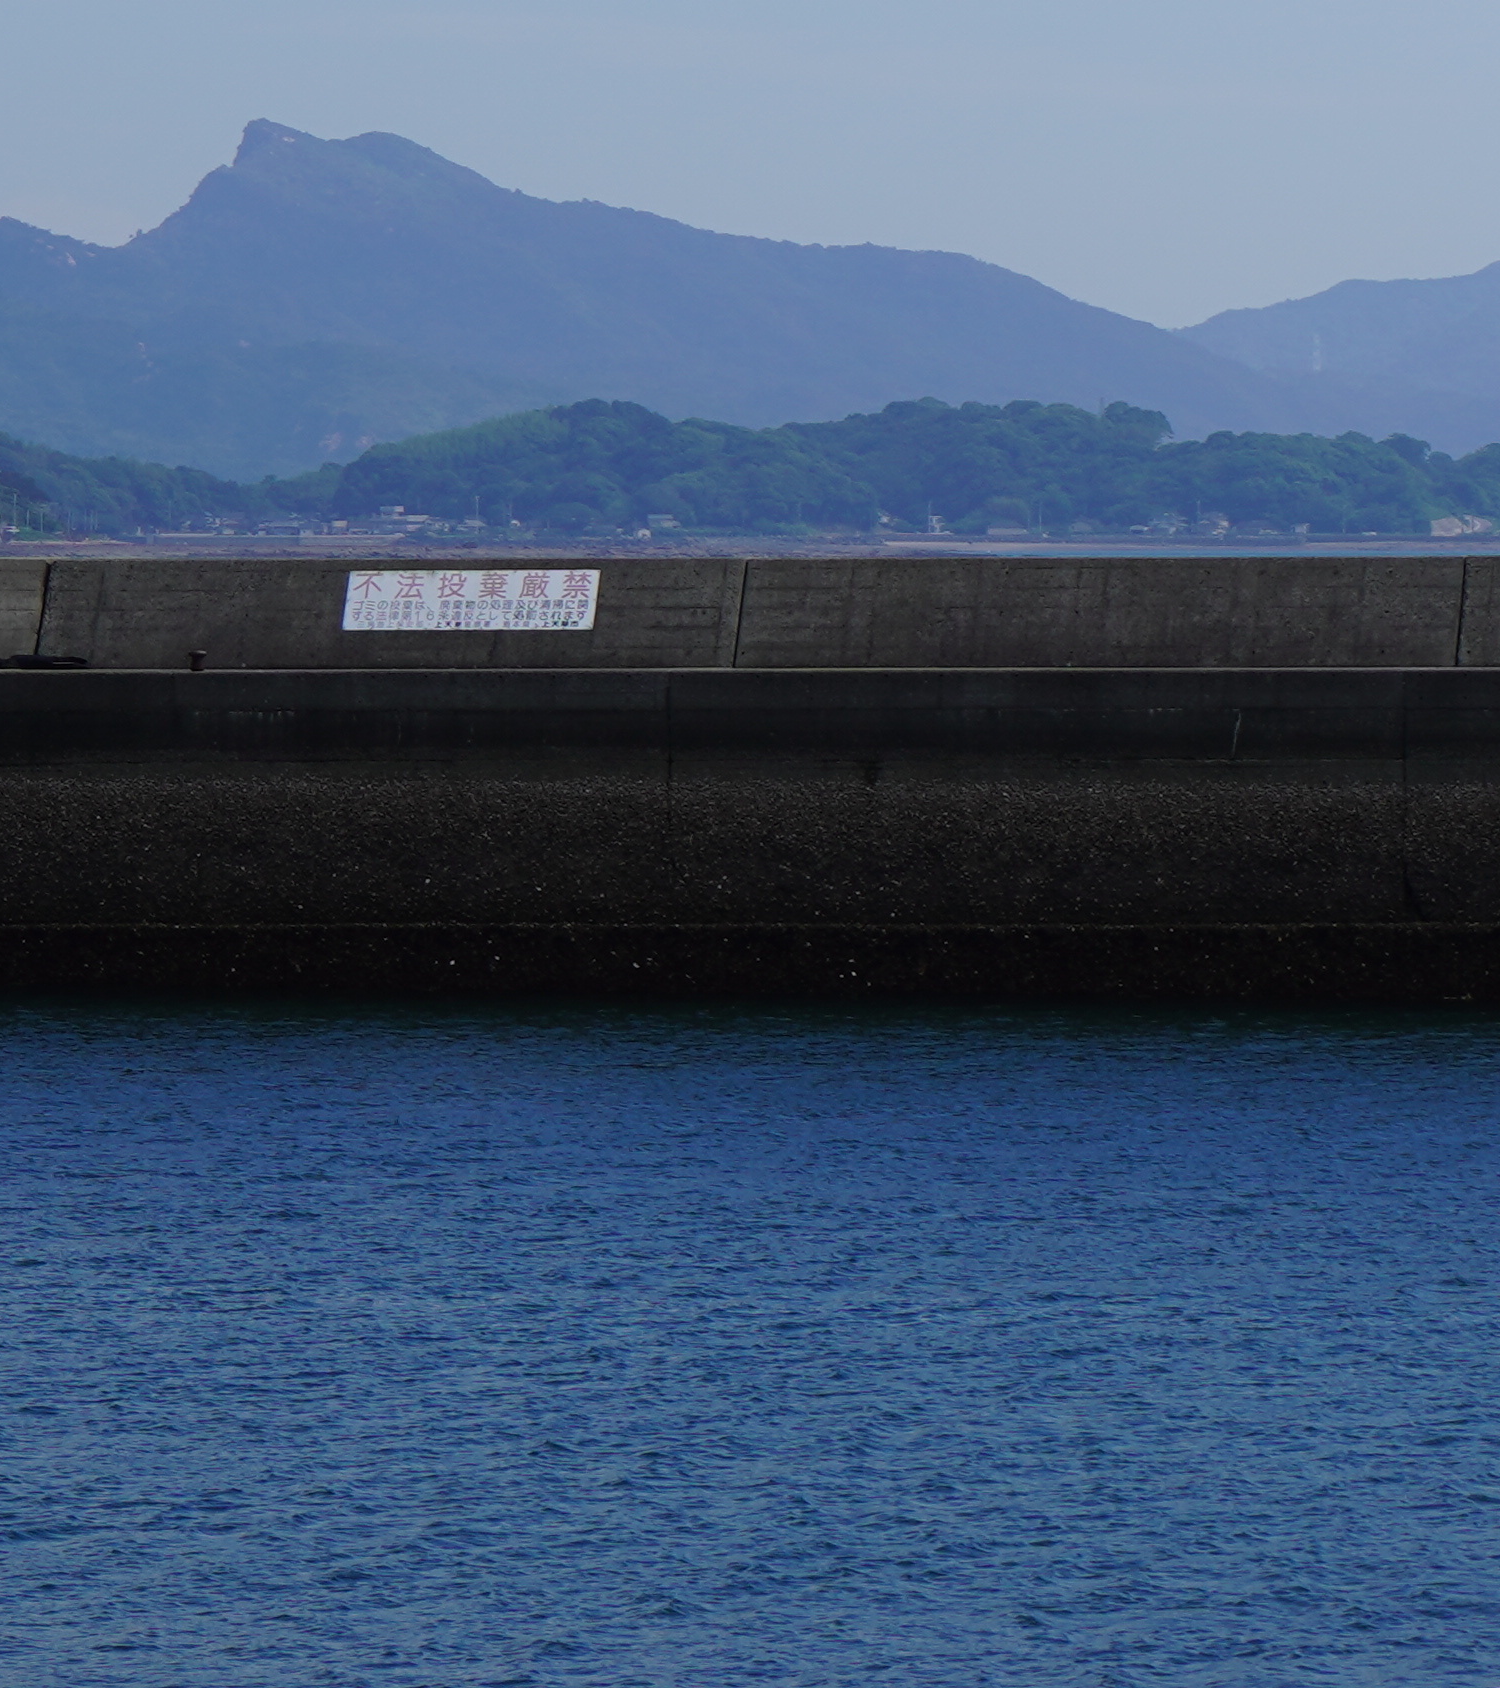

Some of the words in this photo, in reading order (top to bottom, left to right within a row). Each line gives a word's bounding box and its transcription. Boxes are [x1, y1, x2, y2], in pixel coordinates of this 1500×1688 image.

[353, 571, 592, 599] 不法投棄厳禁
